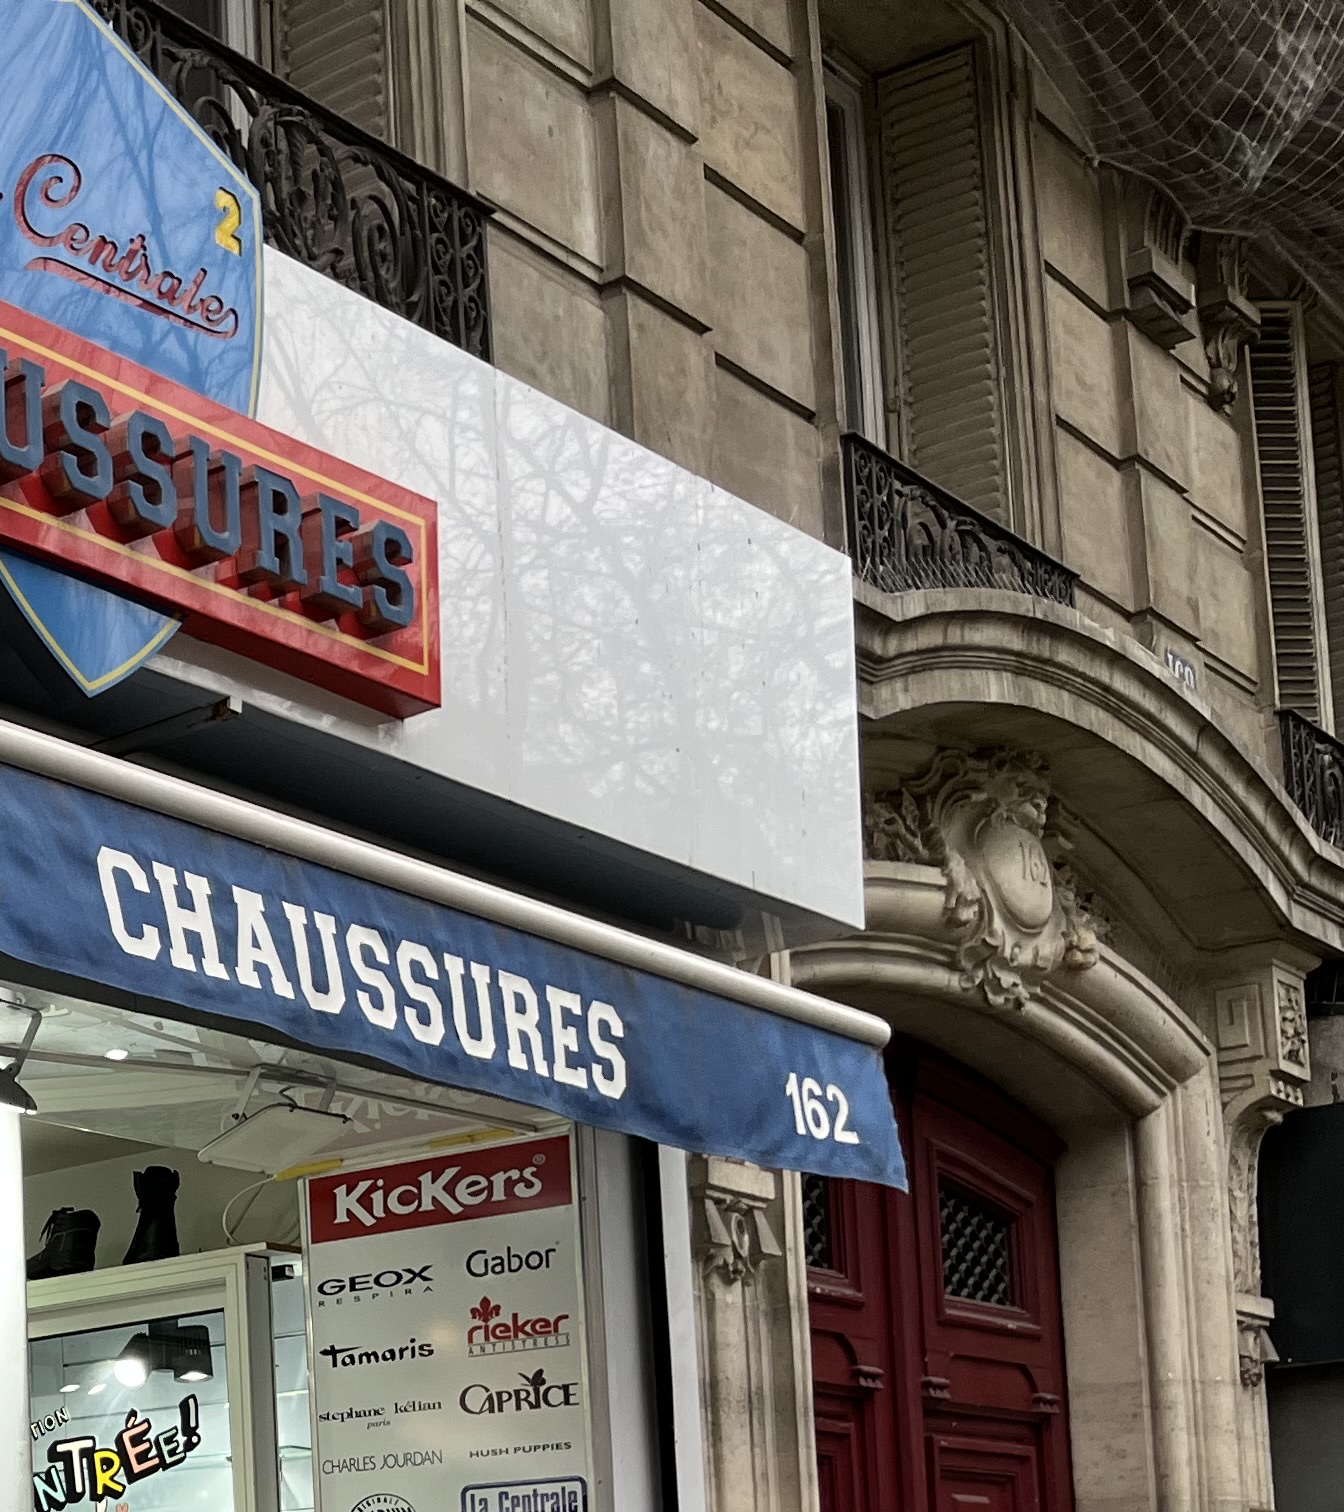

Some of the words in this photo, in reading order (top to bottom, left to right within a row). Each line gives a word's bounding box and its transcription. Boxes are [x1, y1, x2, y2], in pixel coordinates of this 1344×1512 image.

[13, 153, 239, 339] Centrale
[214, 186, 243, 257] 2
[96, 846, 628, 1101] CHAUSSURES
[785, 1072, 861, 1145] 162
[466, 1246, 556, 1278] Gabor
[317, 1264, 434, 1296] GEOX
[318, 1285, 434, 1307] RESPIRA
[467, 1312, 569, 1344] rieker
[319, 1337, 435, 1368] Tamaris
[318, 1406, 386, 1422] stephane
[394, 1400, 442, 1414] kélian
[459, 1381, 581, 1415] CAPRICE
[366, 1419, 391, 1431] paris
[322, 1456, 377, 1475] CHARLES
[379, 1449, 443, 1470] JOURDAN
[469, 1447, 510, 1458] HUSH
[513, 1442, 572, 1454] PUPPIES
